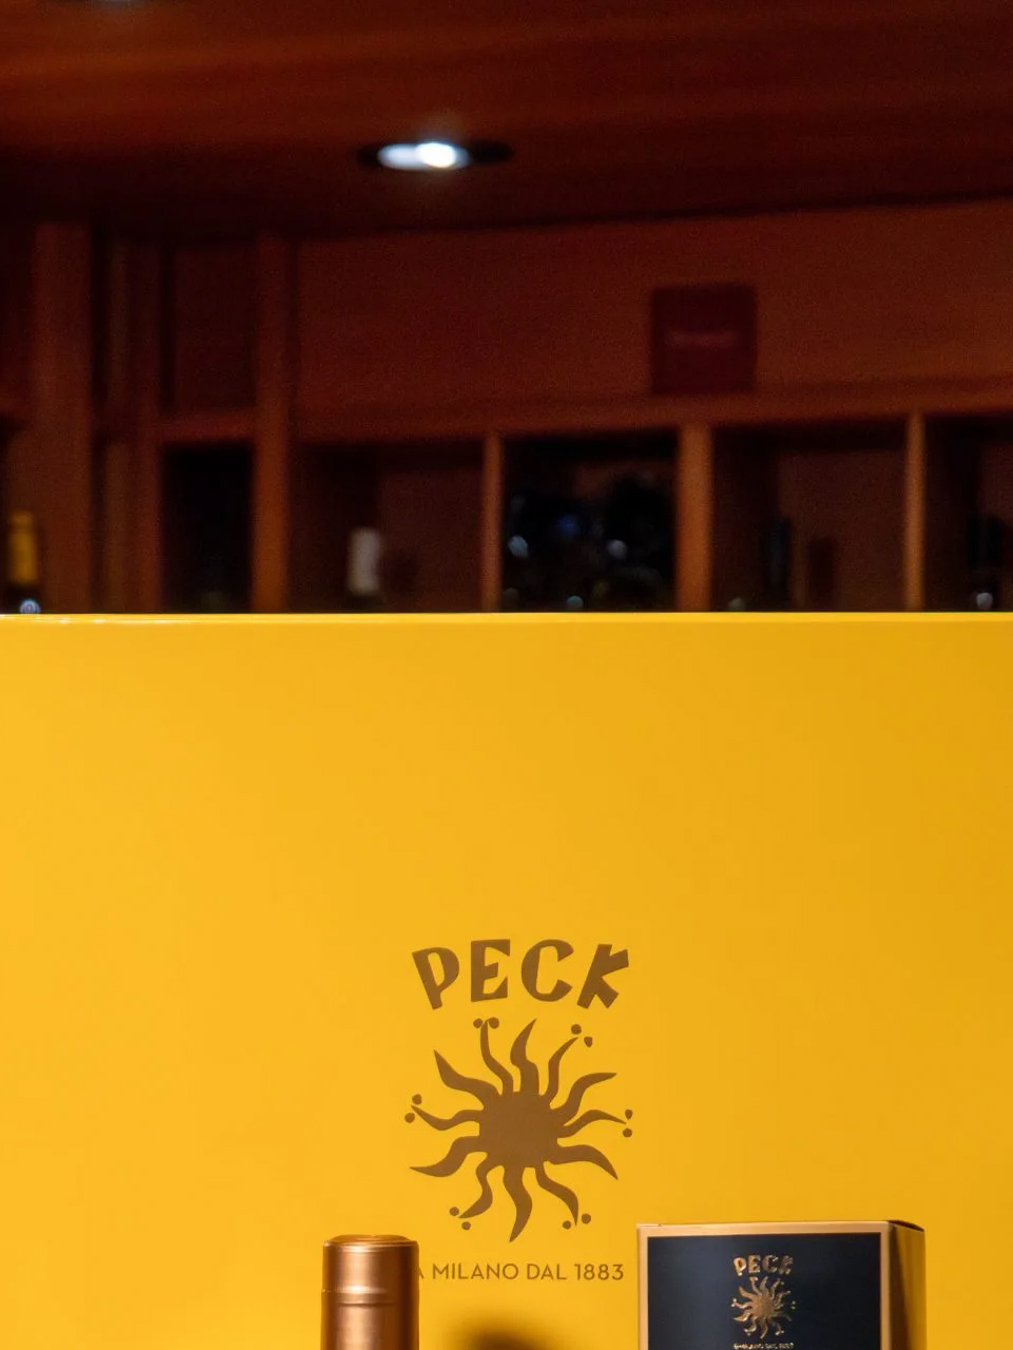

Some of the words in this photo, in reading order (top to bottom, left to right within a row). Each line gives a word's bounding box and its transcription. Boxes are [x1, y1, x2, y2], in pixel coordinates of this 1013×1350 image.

[411, 939, 629, 1010] PECK
[432, 1263, 519, 1280] MILANO
[526, 1263, 567, 1280] DAL
[574, 1263, 624, 1280] 1883
[733, 1255, 794, 1276] PECK
